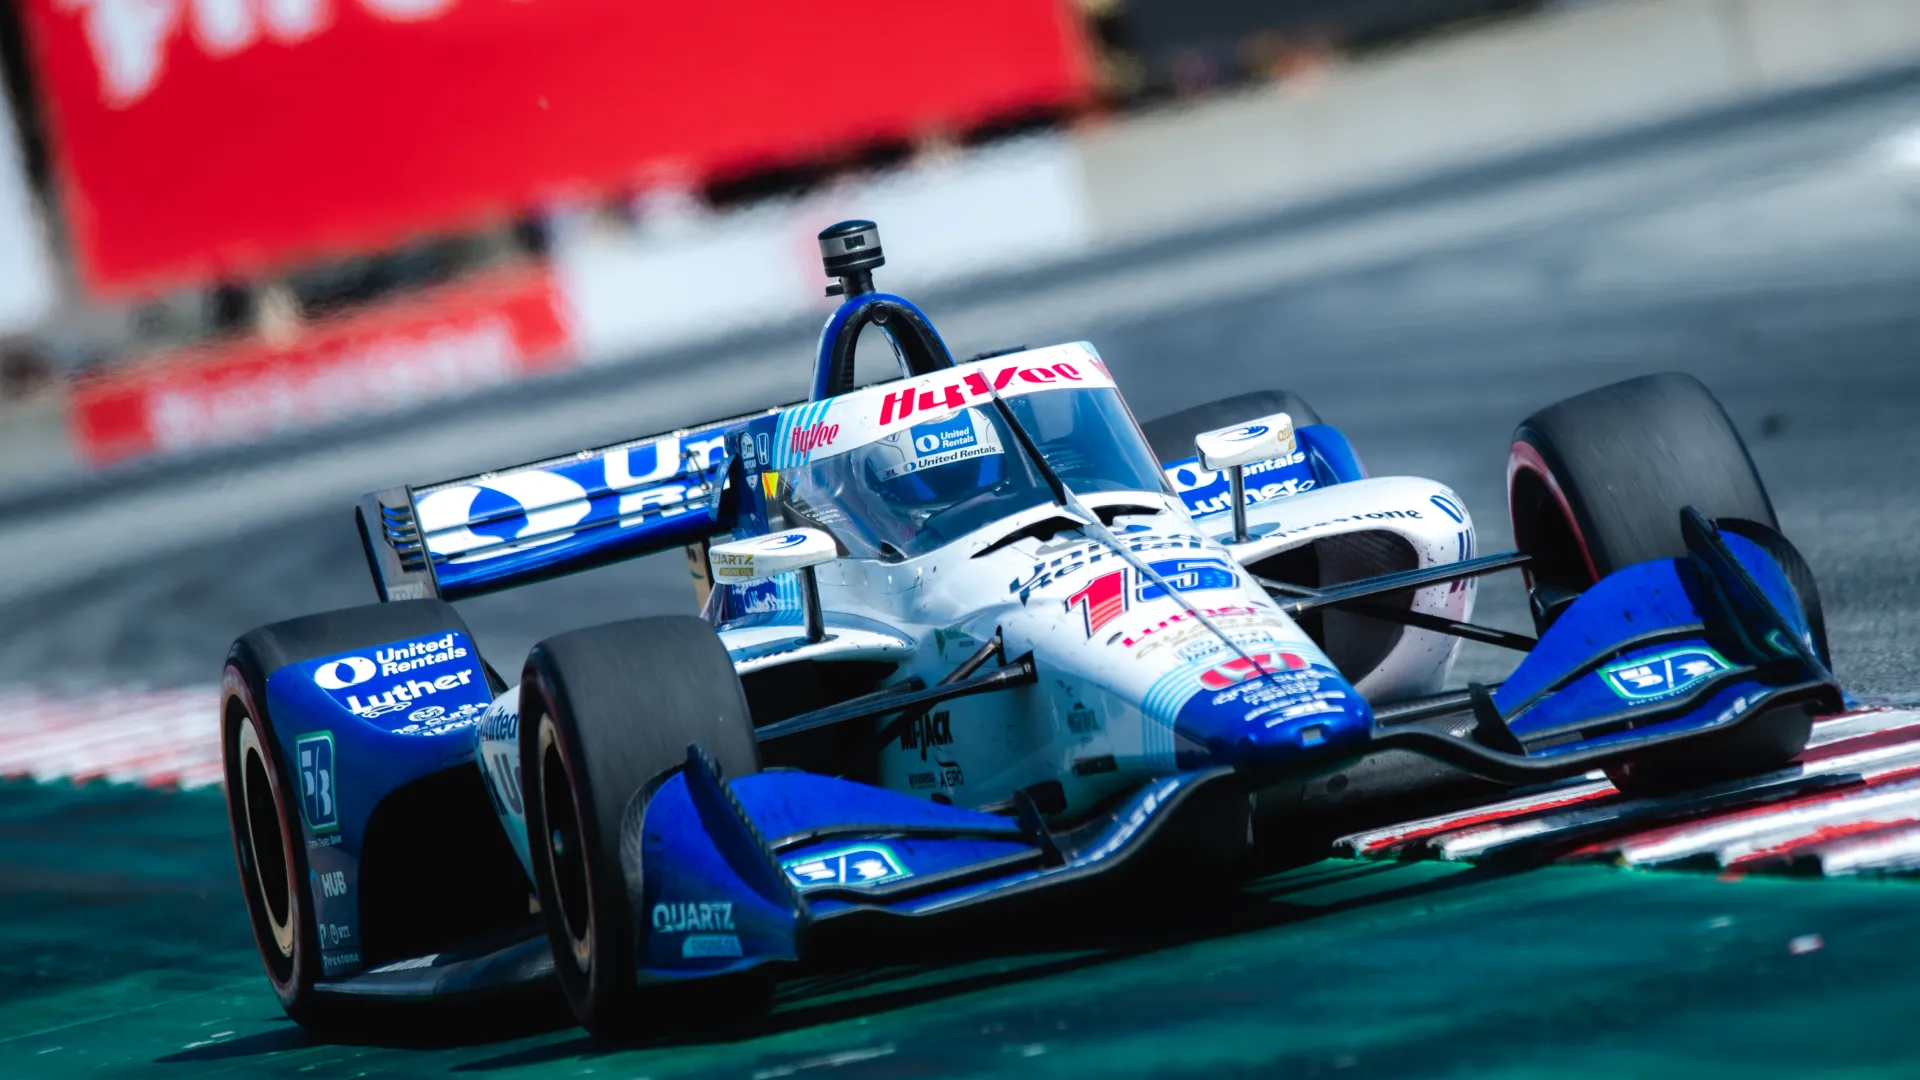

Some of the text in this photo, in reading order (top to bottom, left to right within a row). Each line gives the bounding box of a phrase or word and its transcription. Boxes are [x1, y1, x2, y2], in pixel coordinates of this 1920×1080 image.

[879, 362, 1084, 426] HyVee
[791, 421, 840, 459] HyVee
[940, 426, 970, 441] United
[942, 434, 974, 449] Rentals
[918, 445, 996, 469] United Rentals
[1065, 557, 1241, 640] 15
[375, 633, 455, 665] United
[381, 647, 468, 677] Rentals
[347, 669, 472, 715] Luther
[321, 870, 347, 898] HUB
[652, 901, 735, 933] QUARTZ
